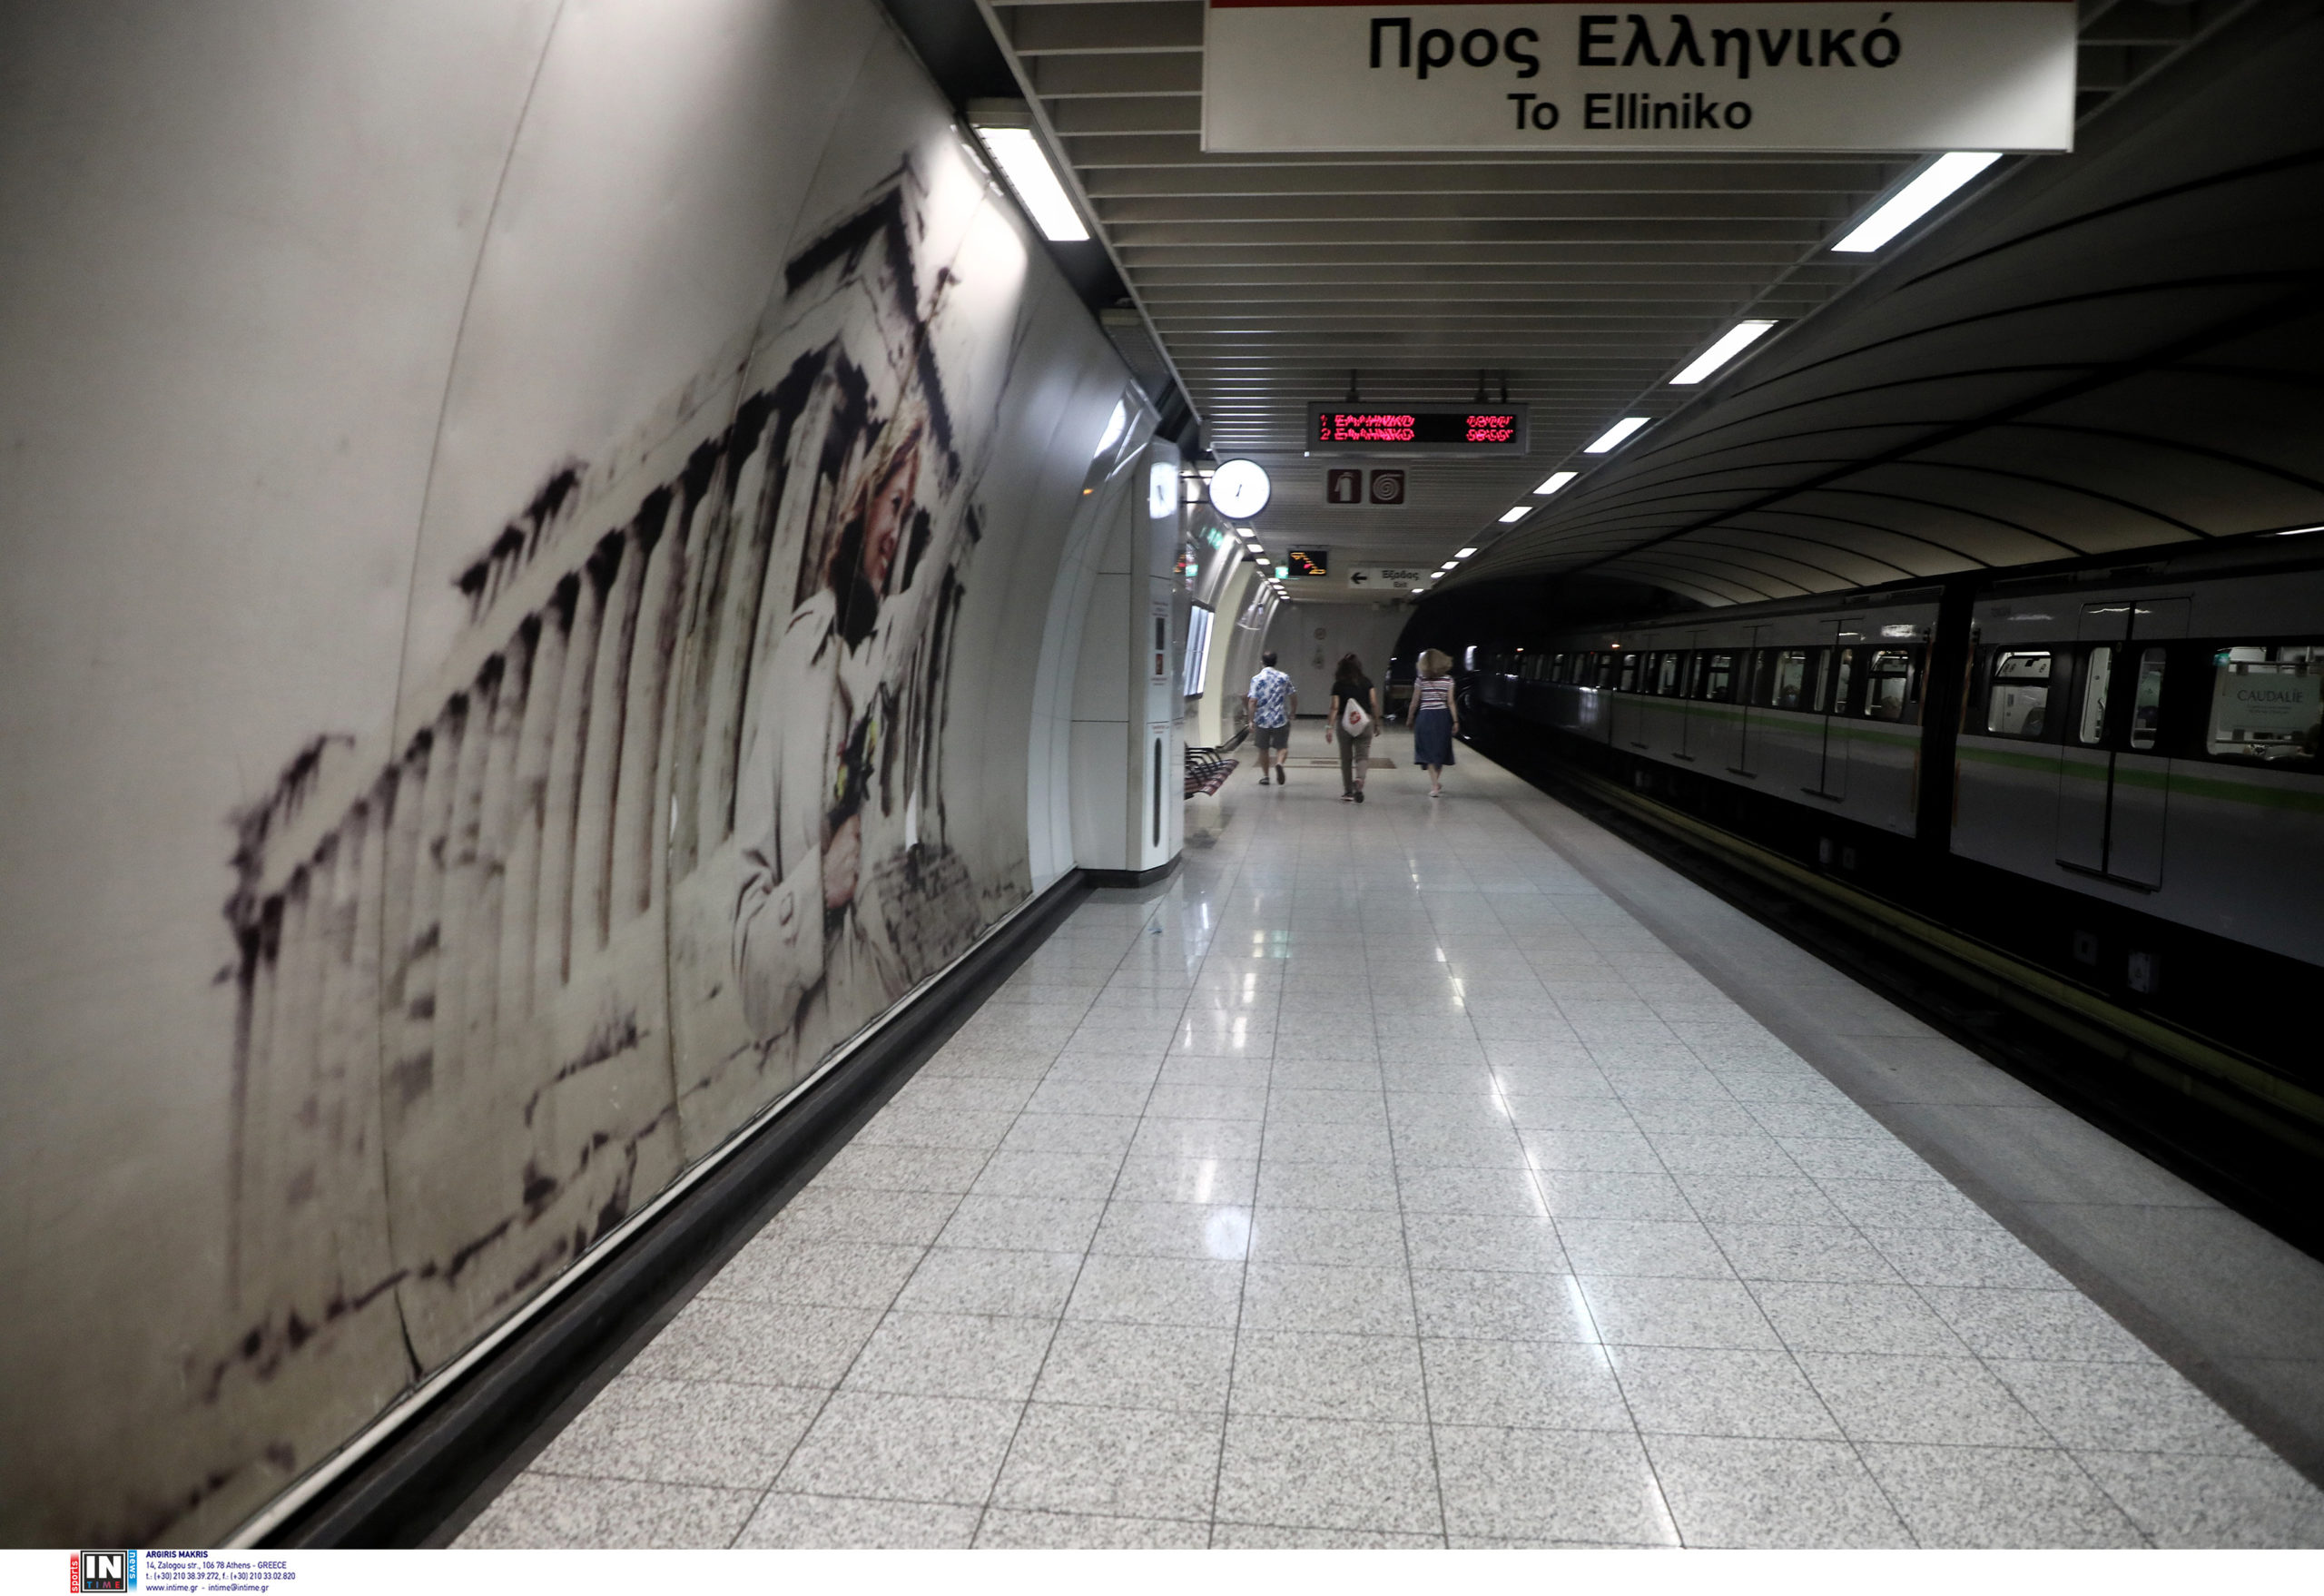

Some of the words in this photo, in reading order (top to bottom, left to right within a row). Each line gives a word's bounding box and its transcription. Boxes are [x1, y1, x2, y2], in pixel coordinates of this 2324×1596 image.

[1369, 16, 1541, 80] Προς
[1578, 12, 1902, 80] Ελληνικό
[1507, 93, 1560, 131] To
[1583, 92, 1753, 131] Elliniko
[1320, 428, 1331, 440] 2
